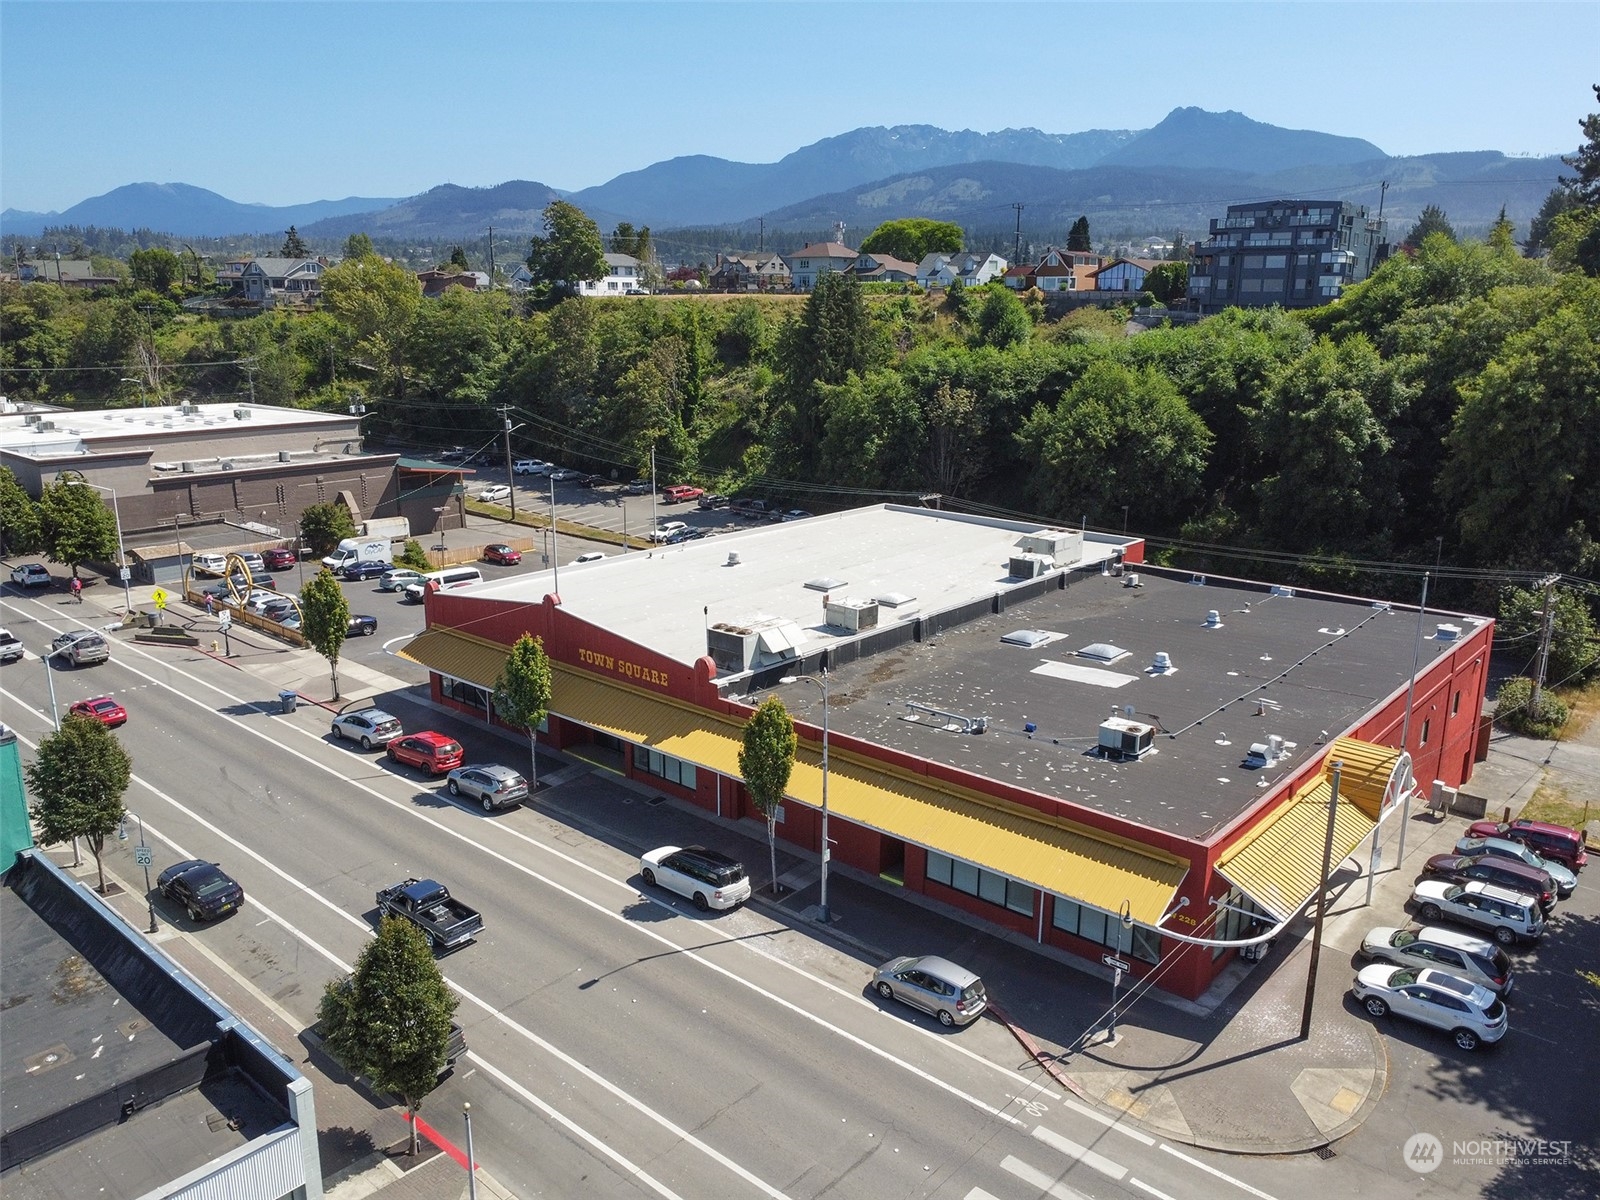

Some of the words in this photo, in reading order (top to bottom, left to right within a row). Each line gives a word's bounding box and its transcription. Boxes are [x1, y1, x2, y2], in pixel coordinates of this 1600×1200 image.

[579, 648, 614, 670] TOWN
[618, 660, 668, 687] SQUARE
[137, 856, 151, 865] 20
